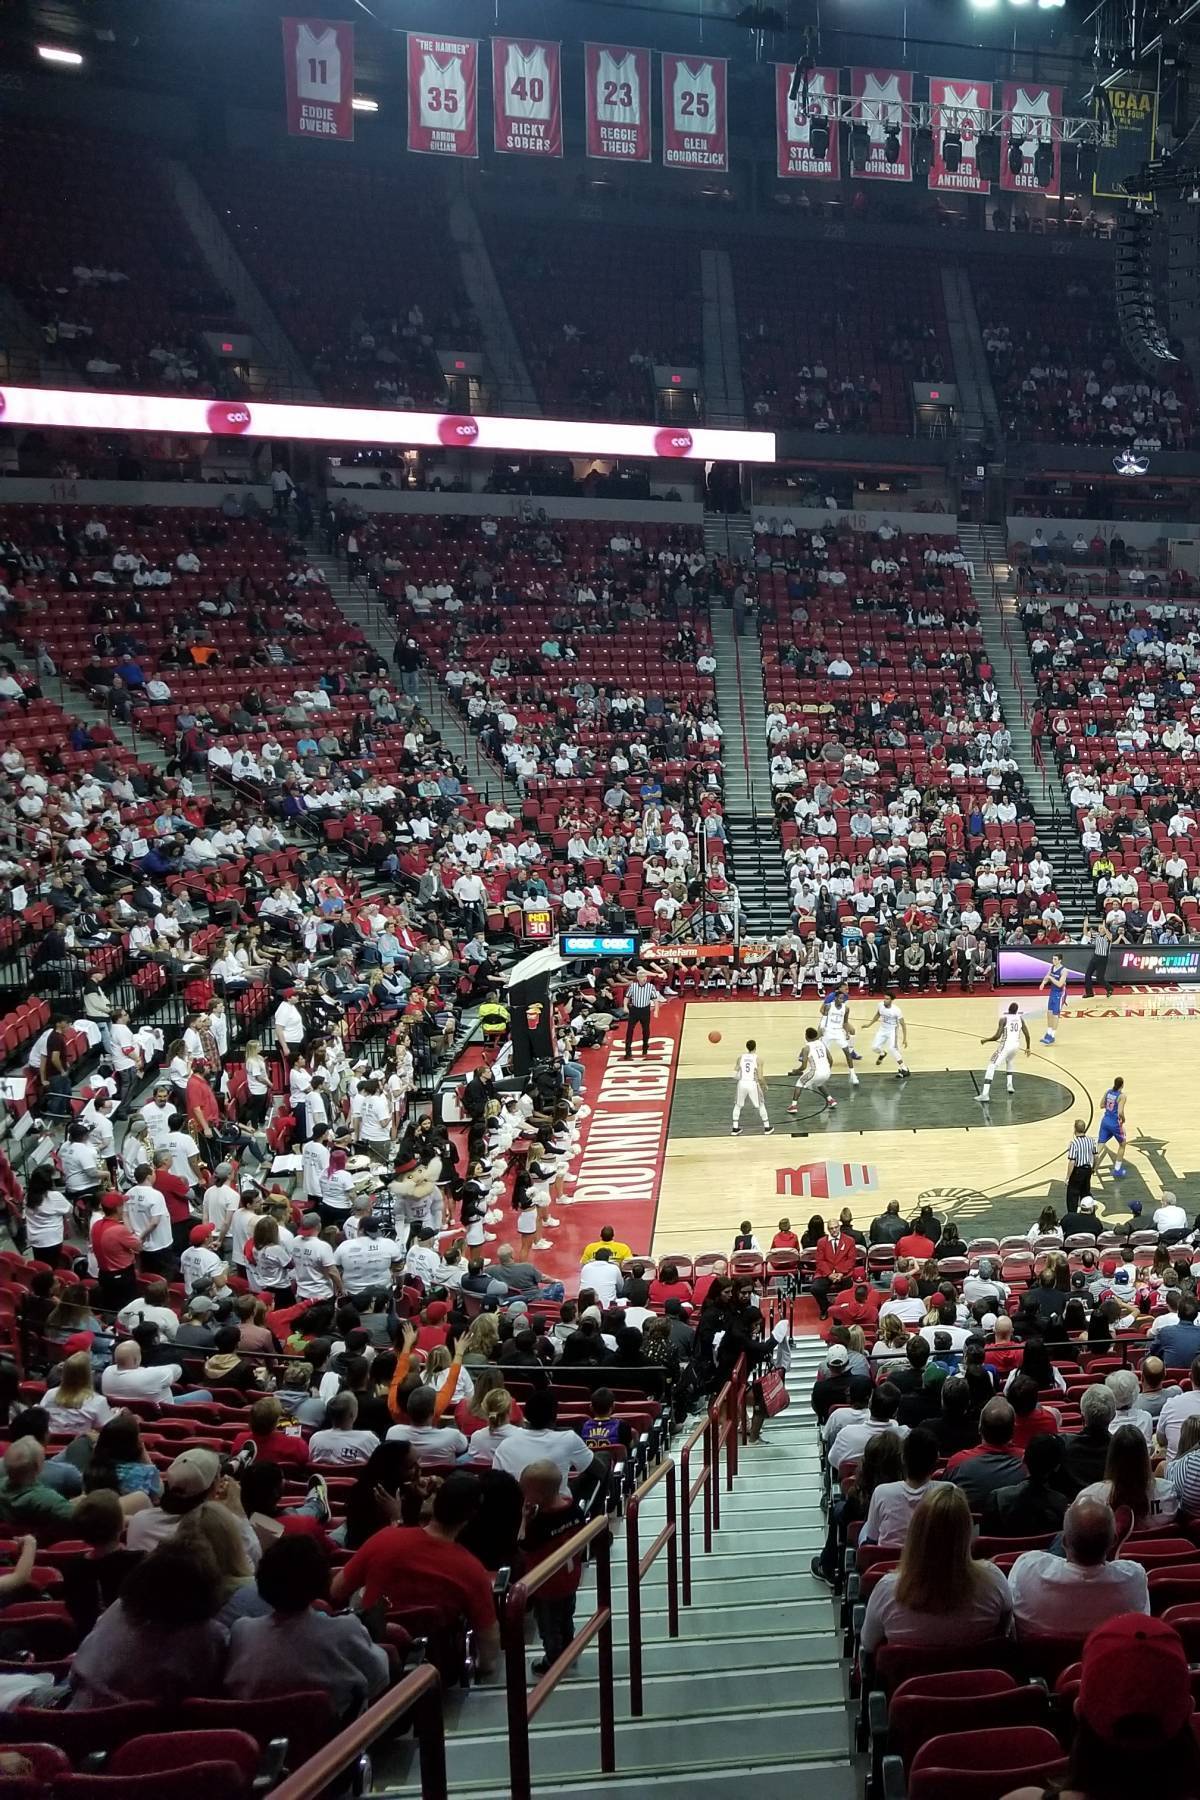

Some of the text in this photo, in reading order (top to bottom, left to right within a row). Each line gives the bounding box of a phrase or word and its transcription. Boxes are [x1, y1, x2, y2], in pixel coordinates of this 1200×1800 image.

[308, 58, 327, 84] 11
[511, 76, 544, 102] 40
[604, 80, 632, 107] 23
[428, 87, 458, 113] 35
[680, 91, 710, 118] 25
[302, 105, 334, 121] EDDIE
[300, 118, 337, 134] OWENS
[512, 122, 545, 136] RICKY
[600, 127, 637, 141] REGGIE
[506, 136, 550, 151] SOBERS
[603, 140, 636, 154] THEUS
[684, 138, 708, 150] GLEN
[666, 150, 724, 165] GONDREZICK
[788, 160, 832, 172] AUGMON
[866, 161, 905, 175] OHNSON
[938, 174, 980, 188] ANTHONY
[50, 483, 77, 499] 114
[530, 922, 546, 934] 30
[1122, 952, 1200, 969] Peppermill
[1010, 1022, 1018, 1032] 30
[816, 1048, 824, 1059] 13
[597, 1036, 674, 1102] REBELS
[574, 1109, 664, 1202] RUNNIN'
[590, 1428, 610, 1438] JAMES
